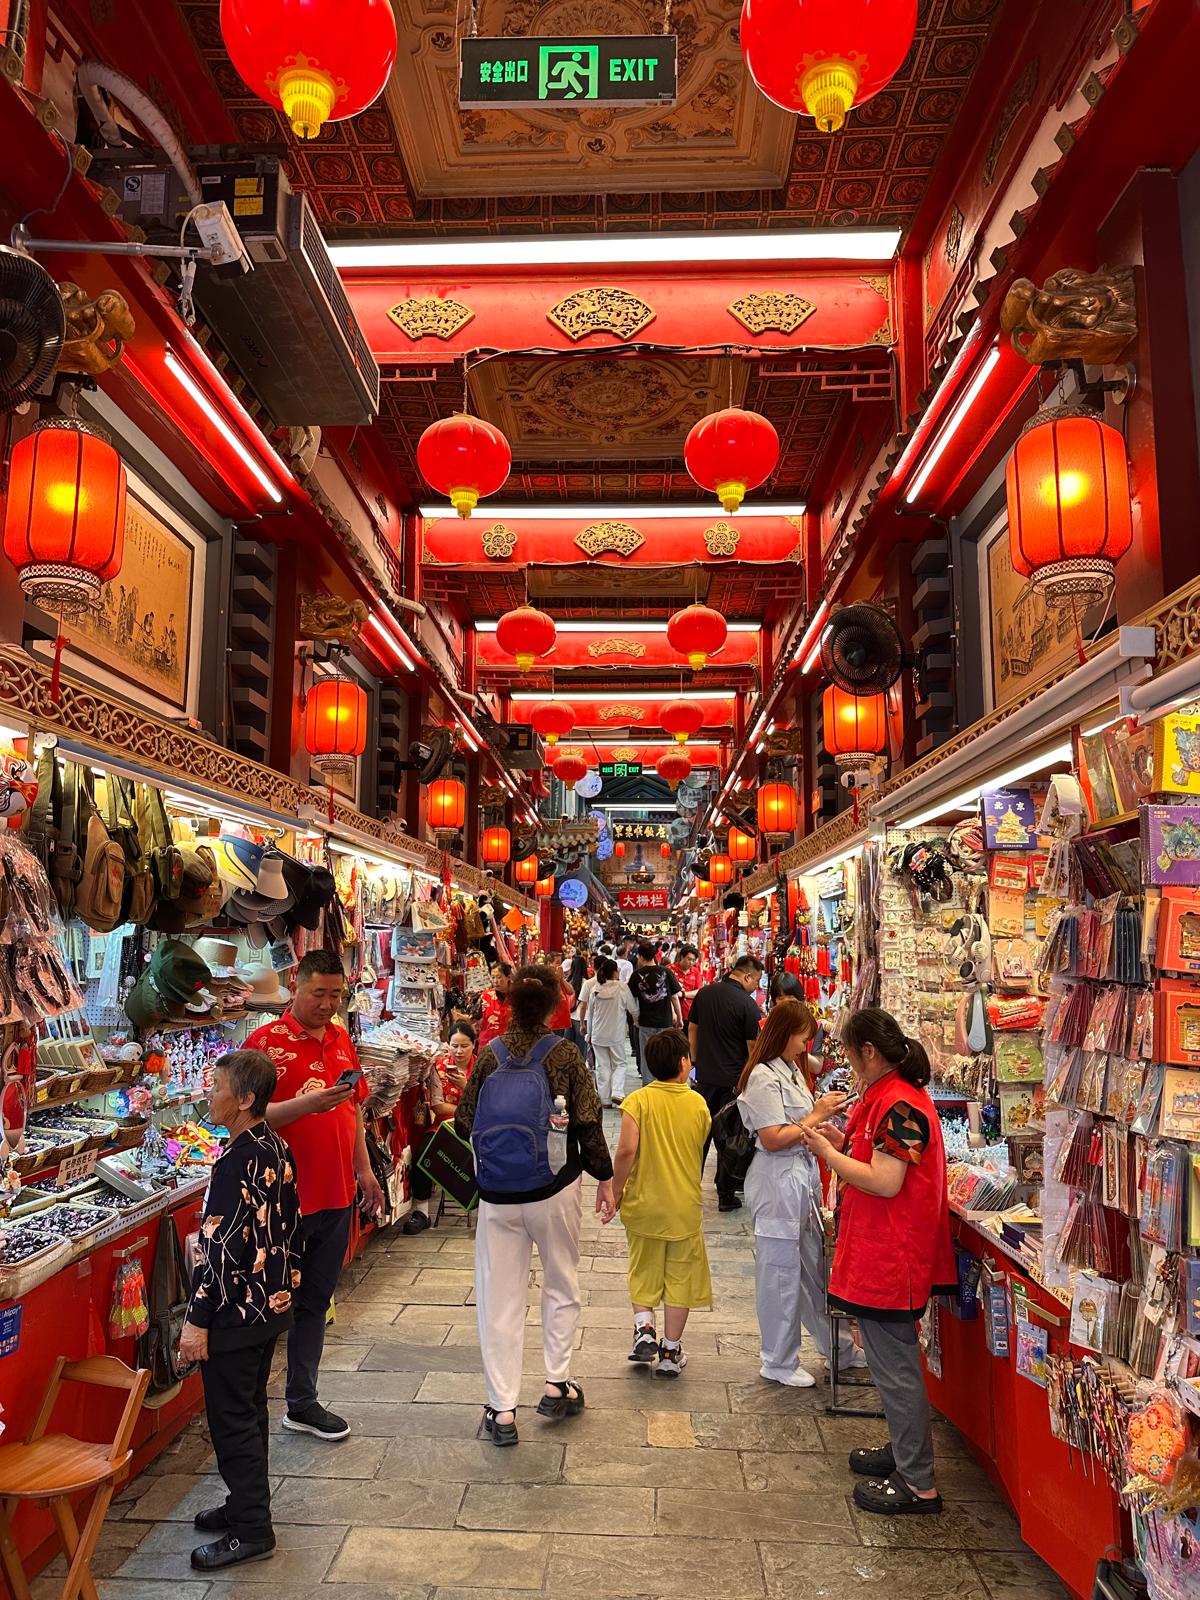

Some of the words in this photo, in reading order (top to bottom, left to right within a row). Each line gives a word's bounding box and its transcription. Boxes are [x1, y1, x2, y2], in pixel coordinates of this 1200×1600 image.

[480, 60, 529, 83] 安全出口
[609, 58, 658, 82] EXIT
[622, 893, 665, 908] 大栅栏
